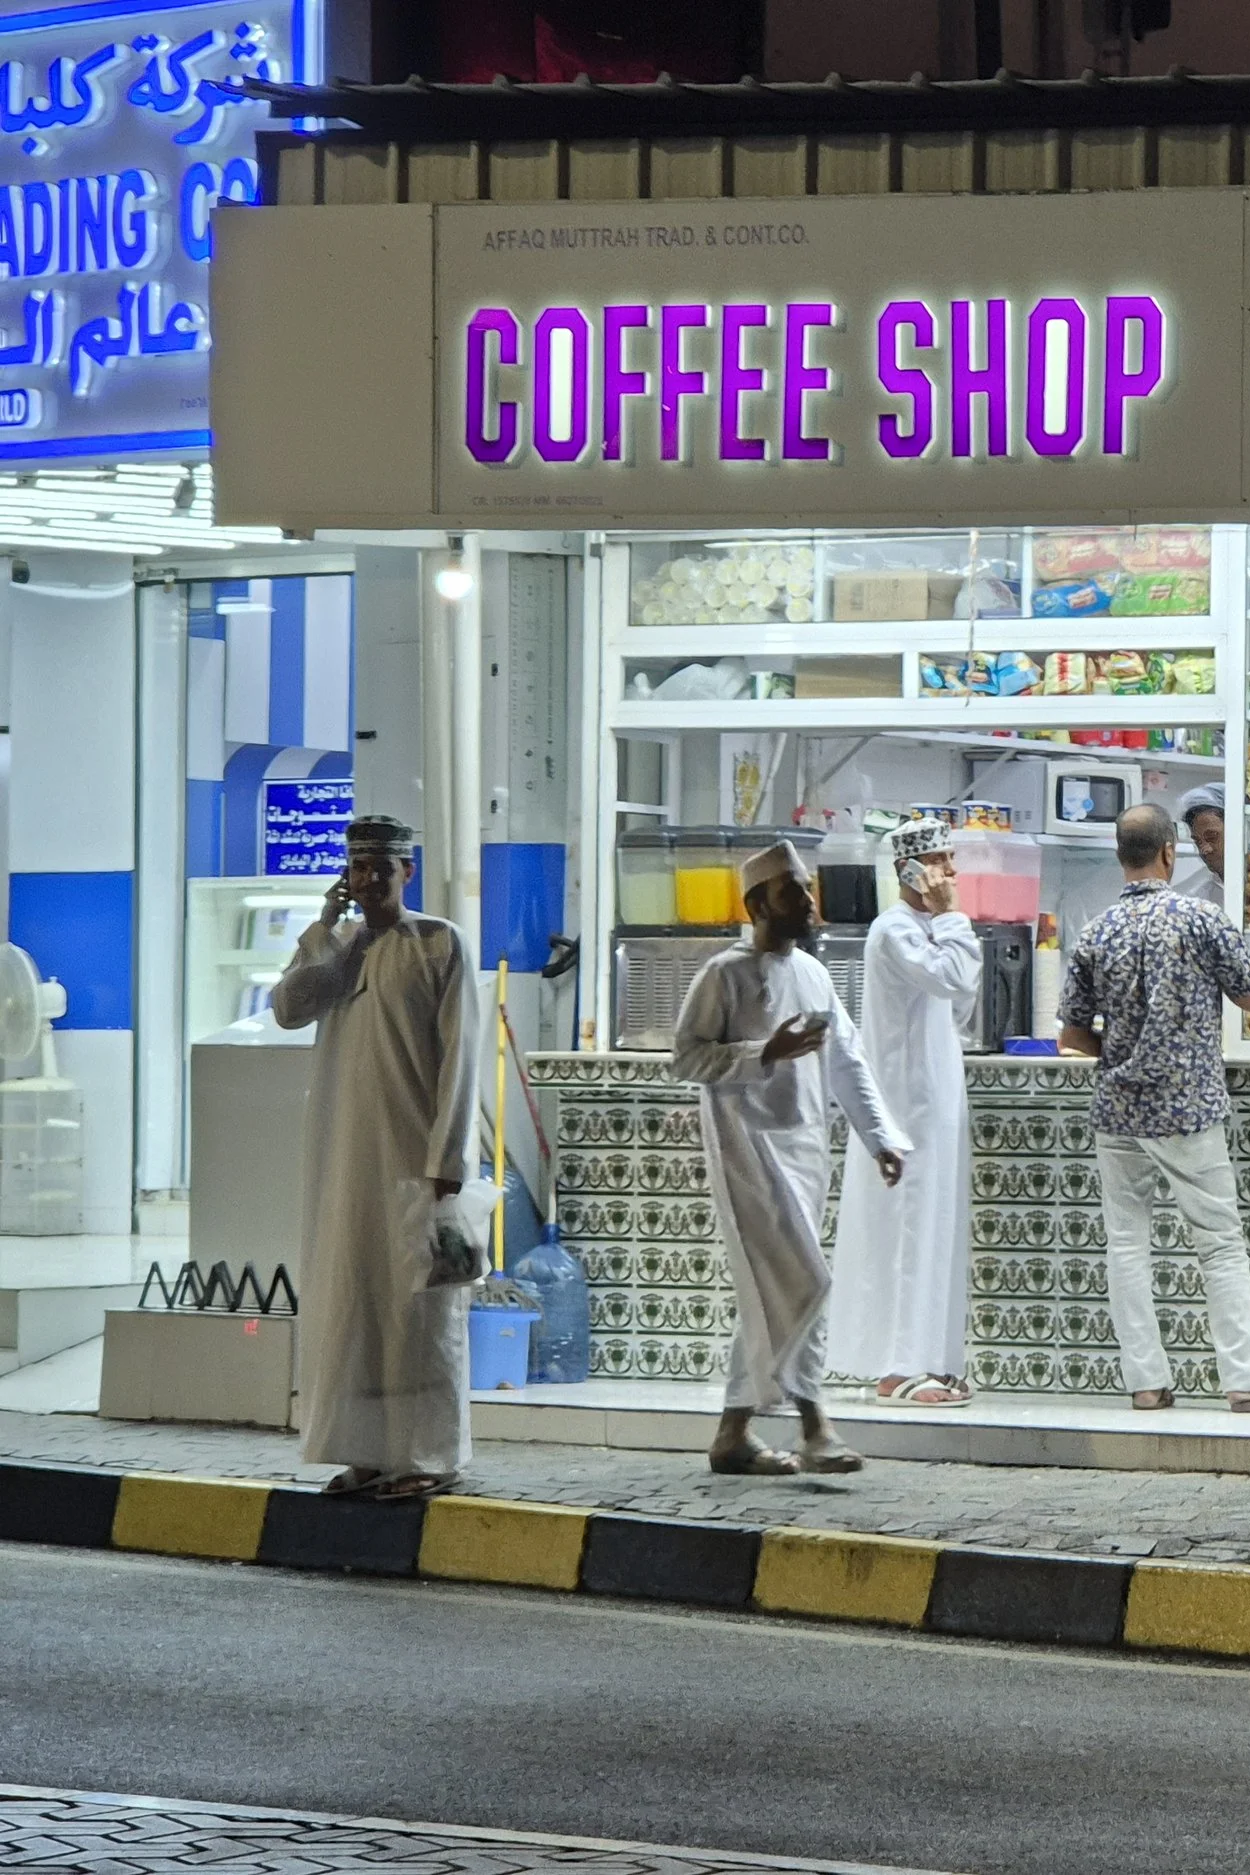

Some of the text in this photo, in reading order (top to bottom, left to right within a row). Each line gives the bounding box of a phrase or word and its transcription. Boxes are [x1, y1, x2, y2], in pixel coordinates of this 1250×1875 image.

[483, 230, 545, 250] AFFAQ
[550, 227, 639, 249] MUTTRAH
[645, 226, 699, 248] TRAD.
[705, 226, 717, 246] &
[0, 288, 54, 365] ال
[465, 296, 1164, 462] COFFEE SHOP
